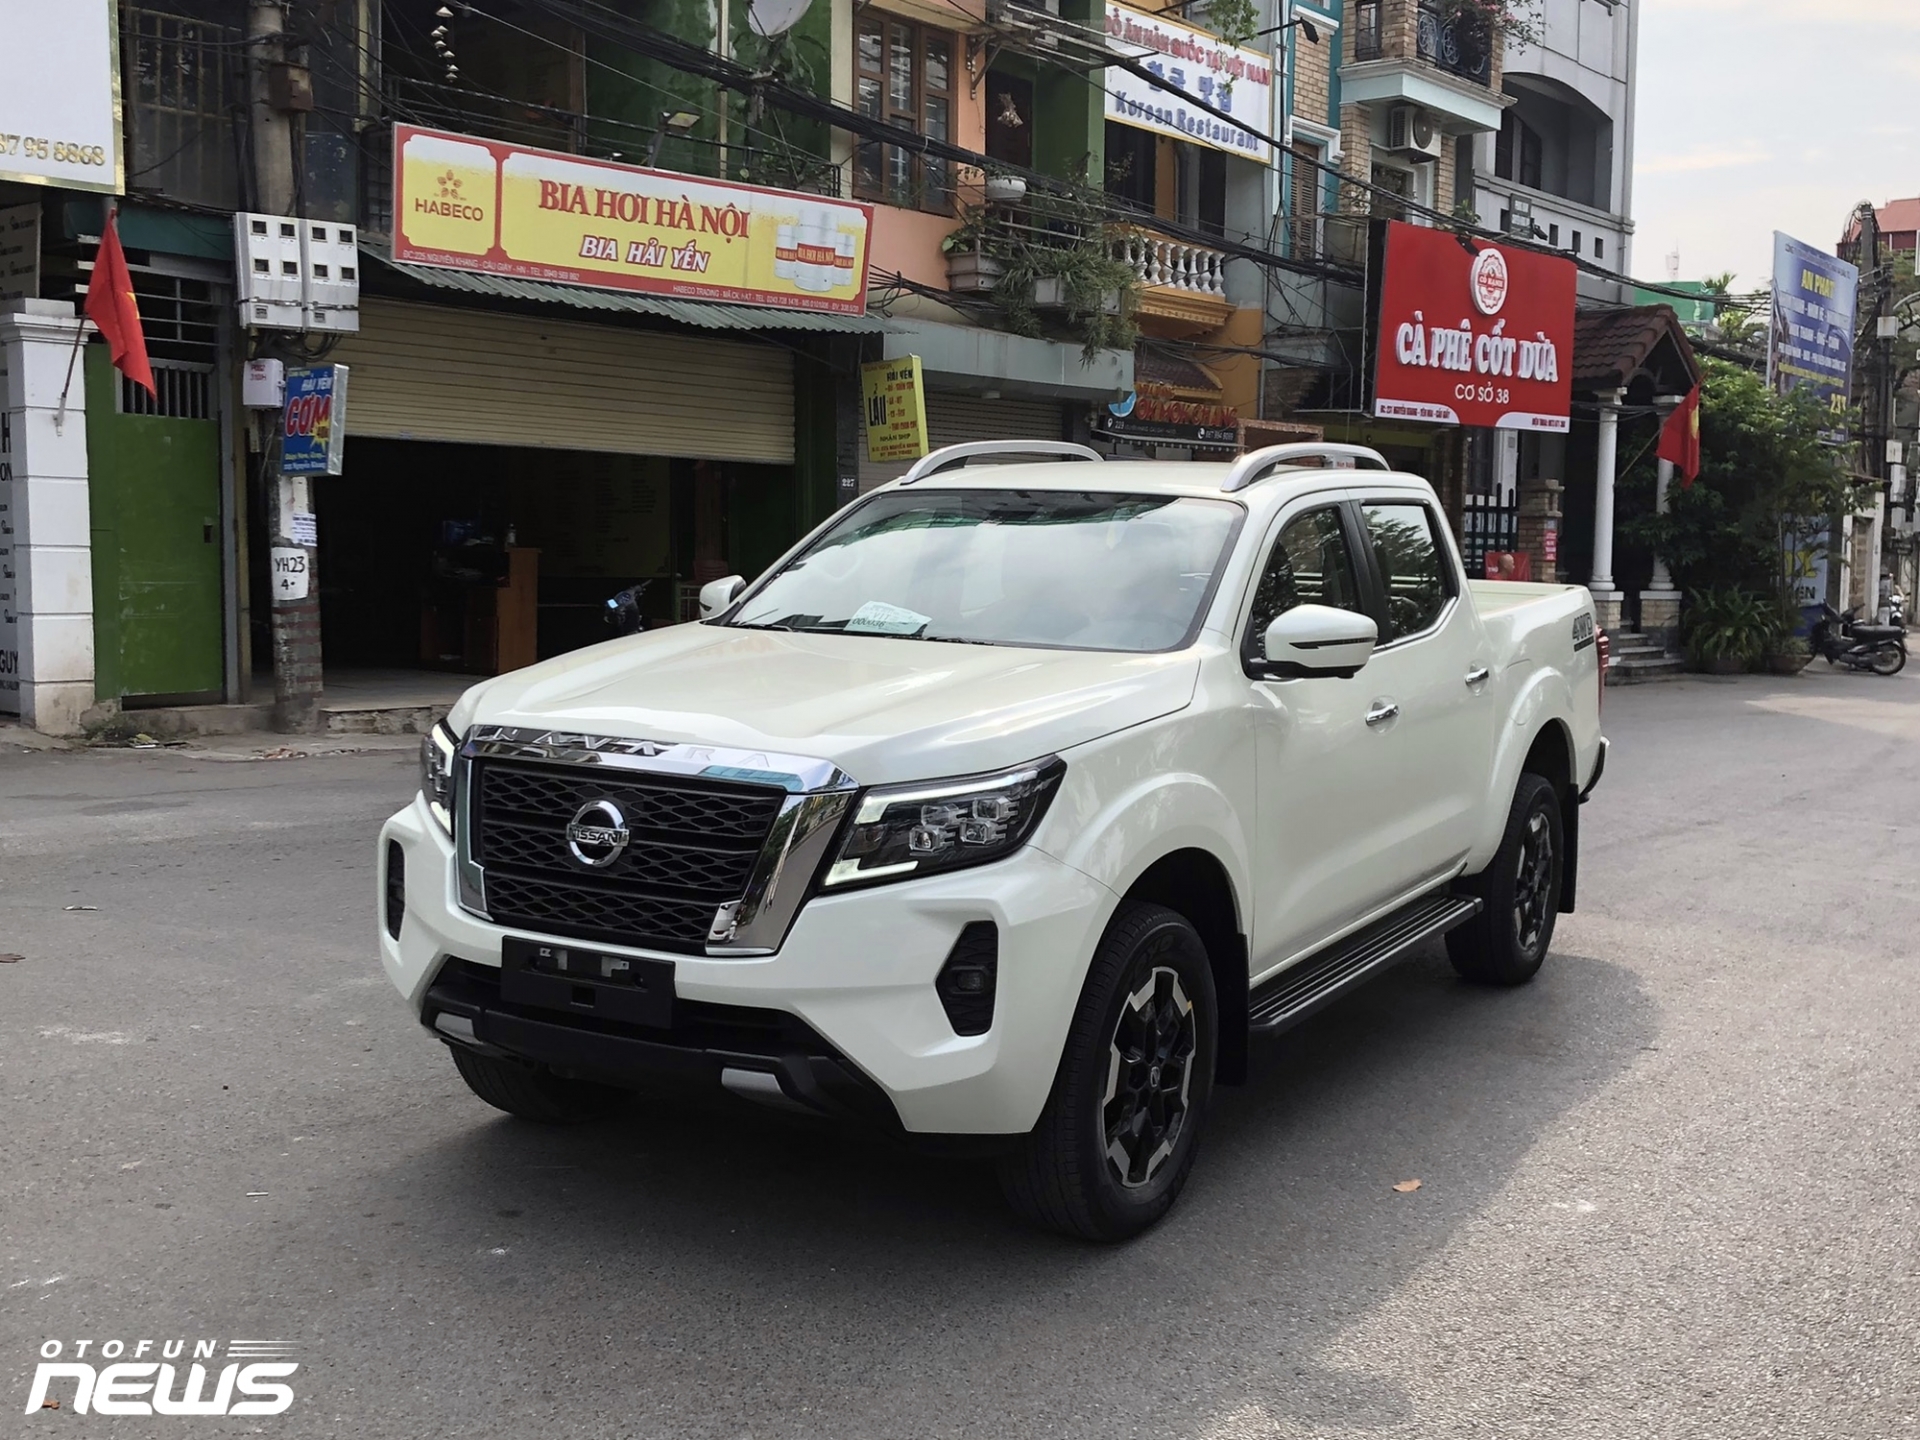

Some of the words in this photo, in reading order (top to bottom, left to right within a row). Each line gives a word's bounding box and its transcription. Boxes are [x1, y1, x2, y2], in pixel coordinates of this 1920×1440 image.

[1170, 34, 1205, 63] QUỐC
[1247, 63, 1271, 87] NAM
[1115, 90, 1173, 127] Korean
[1177, 108, 1259, 151] Restaurant
[23, 136, 49, 160] 95
[53, 141, 105, 167] 8868
[414, 197, 485, 223] HABECO
[538, 178, 591, 217] BIA
[594, 187, 650, 227] HƠI
[653, 193, 696, 233] HÀ
[698, 202, 750, 244] NỘI
[578, 234, 619, 262] BIA
[625, 236, 668, 268] HẢI
[670, 238, 712, 274] YẾN
[672, 285, 696, 295] HABECO
[696, 287, 719, 298] TRADING
[1396, 310, 1427, 366] CÀ
[1428, 318, 1473, 373] PHÊ
[1474, 318, 1517, 377] CỐT
[1517, 331, 1559, 383] DỪA
[1454, 383, 1475, 400] CƠ
[1477, 381, 1494, 403] SỞ
[1495, 388, 1510, 404] 38
[285, 392, 333, 437] CƠM
[491, 727, 771, 769] NAVARA
[571, 830, 621, 845] NISSAN
